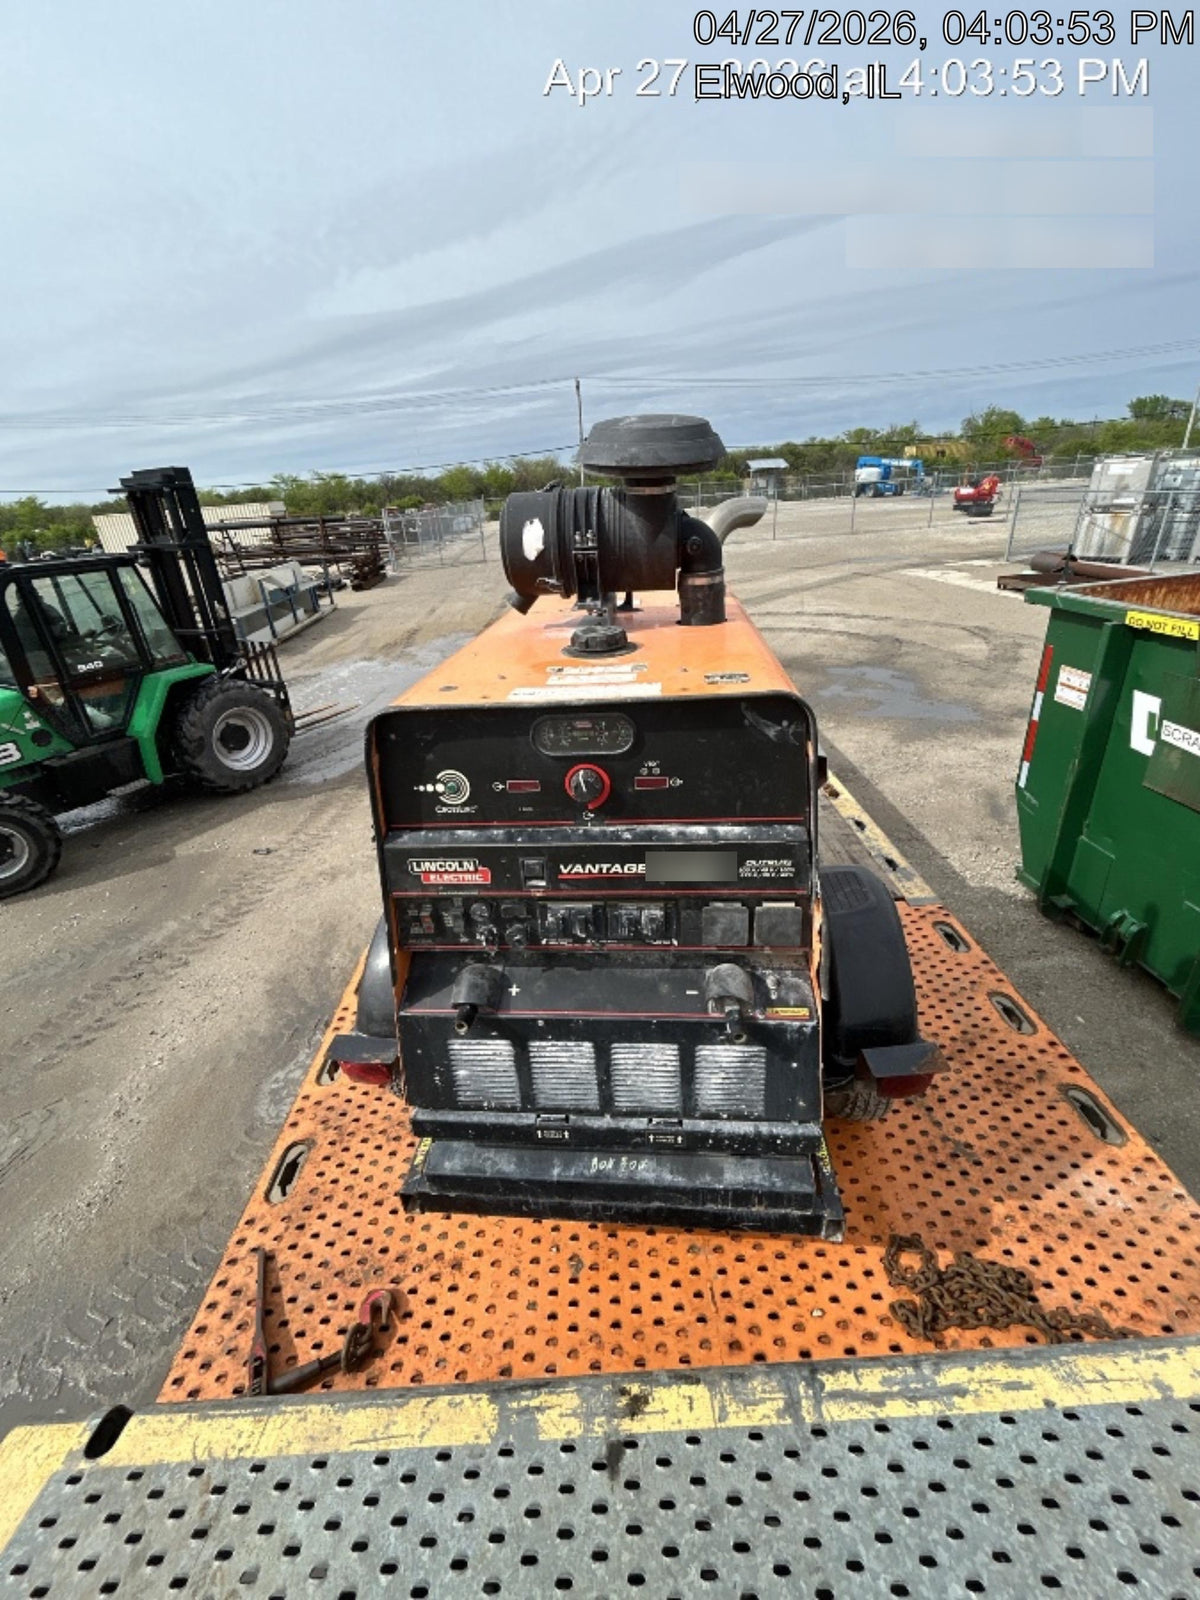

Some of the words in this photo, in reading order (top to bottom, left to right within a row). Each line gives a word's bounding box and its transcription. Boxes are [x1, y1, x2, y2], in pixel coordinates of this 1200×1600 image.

[1146, 619, 1168, 632] NOT
[412, 861, 475, 872] LINCOLN
[559, 863, 646, 874] VANTAGE
[429, 873, 485, 882] ELECTRIC
